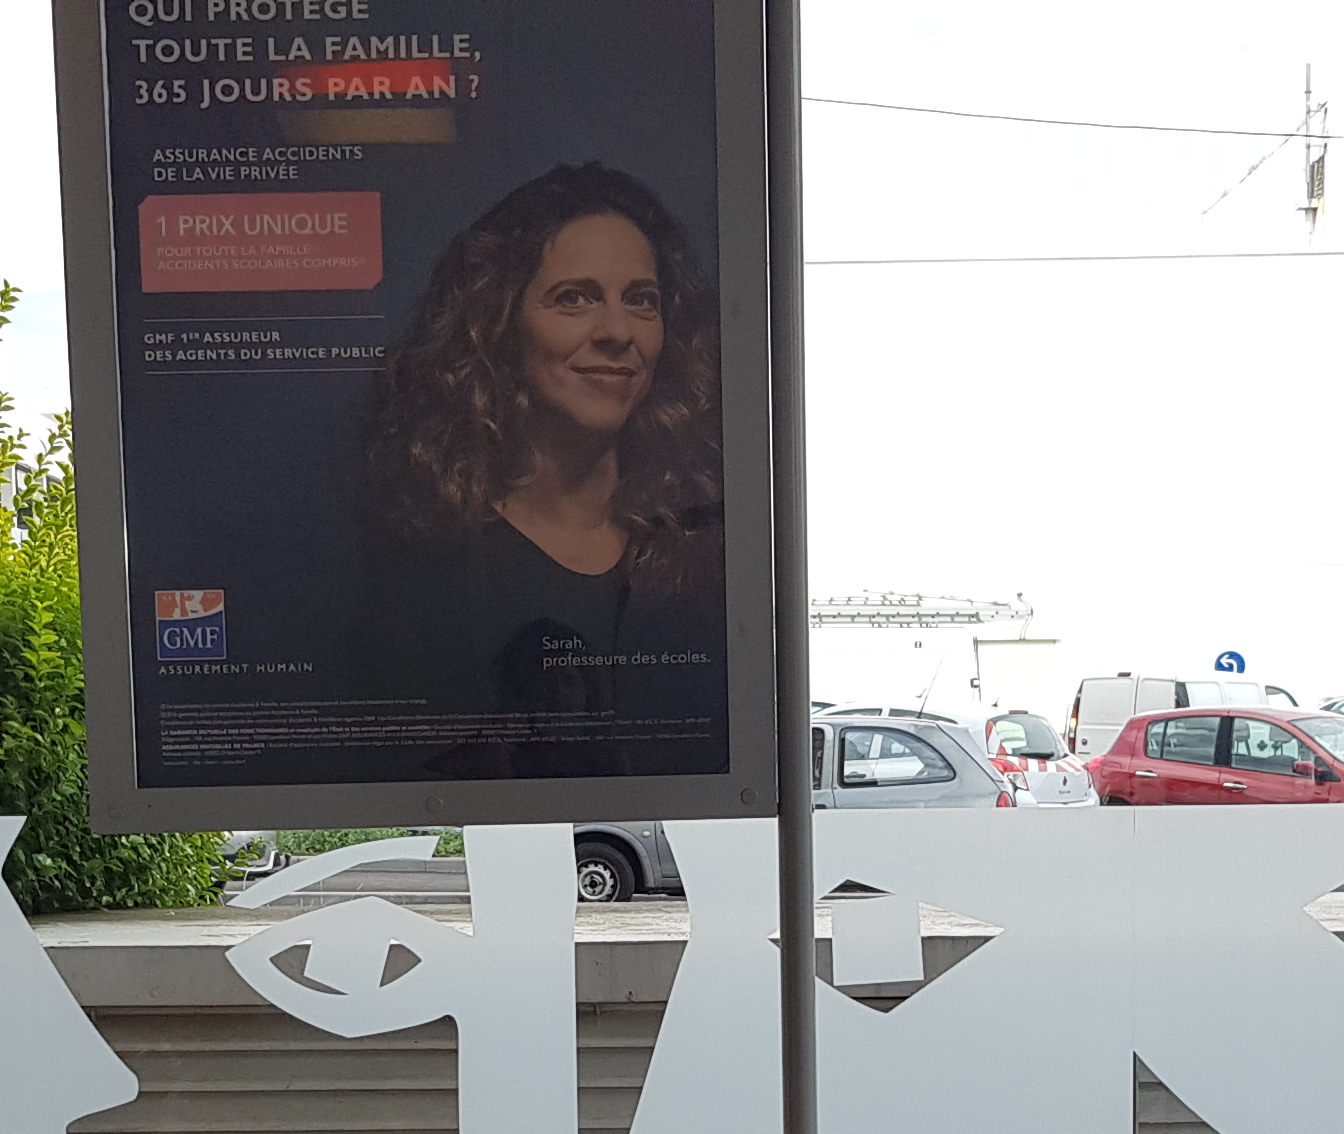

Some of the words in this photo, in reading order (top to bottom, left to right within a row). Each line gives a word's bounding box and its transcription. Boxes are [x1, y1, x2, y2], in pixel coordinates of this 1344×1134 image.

[128, 0, 193, 26] QUI
[131, 37, 255, 63] TOUTE
[267, 36, 312, 61] LA
[325, 33, 481, 63] FAMILLE,
[134, 79, 188, 104] 365
[199, 77, 313, 108] JOURS
[328, 76, 395, 101] PAR
[404, 75, 457, 100] AN
[468, 74, 480, 99] ?
[152, 147, 258, 163] ASSURANCE
[262, 146, 363, 162] ACCIDENTS
[153, 167, 177, 181] DE
[182, 167, 205, 181] LA
[208, 166, 235, 180] VIE
[240, 163, 299, 180] PRIVÉE
[157, 216, 167, 237] 1
[179, 214, 236, 236] PRIX
[243, 212, 349, 236] UNIQUE
[144, 333, 175, 344] GMF
[203, 331, 281, 344] ASSUREUR
[144, 350, 173, 361] DES
[175, 349, 236, 361] AGENTS
[240, 349, 262, 360] DU
[267, 348, 326, 359] SERVICE
[331, 346, 385, 358] PUBLIC
[163, 627, 220, 649] GMF
[542, 636, 586, 650] Sarah,
[256, 662, 314, 673] HUMAIN
[543, 652, 627, 670] professeure
[631, 651, 657, 664] des
[661, 650, 711, 664] écoles.
